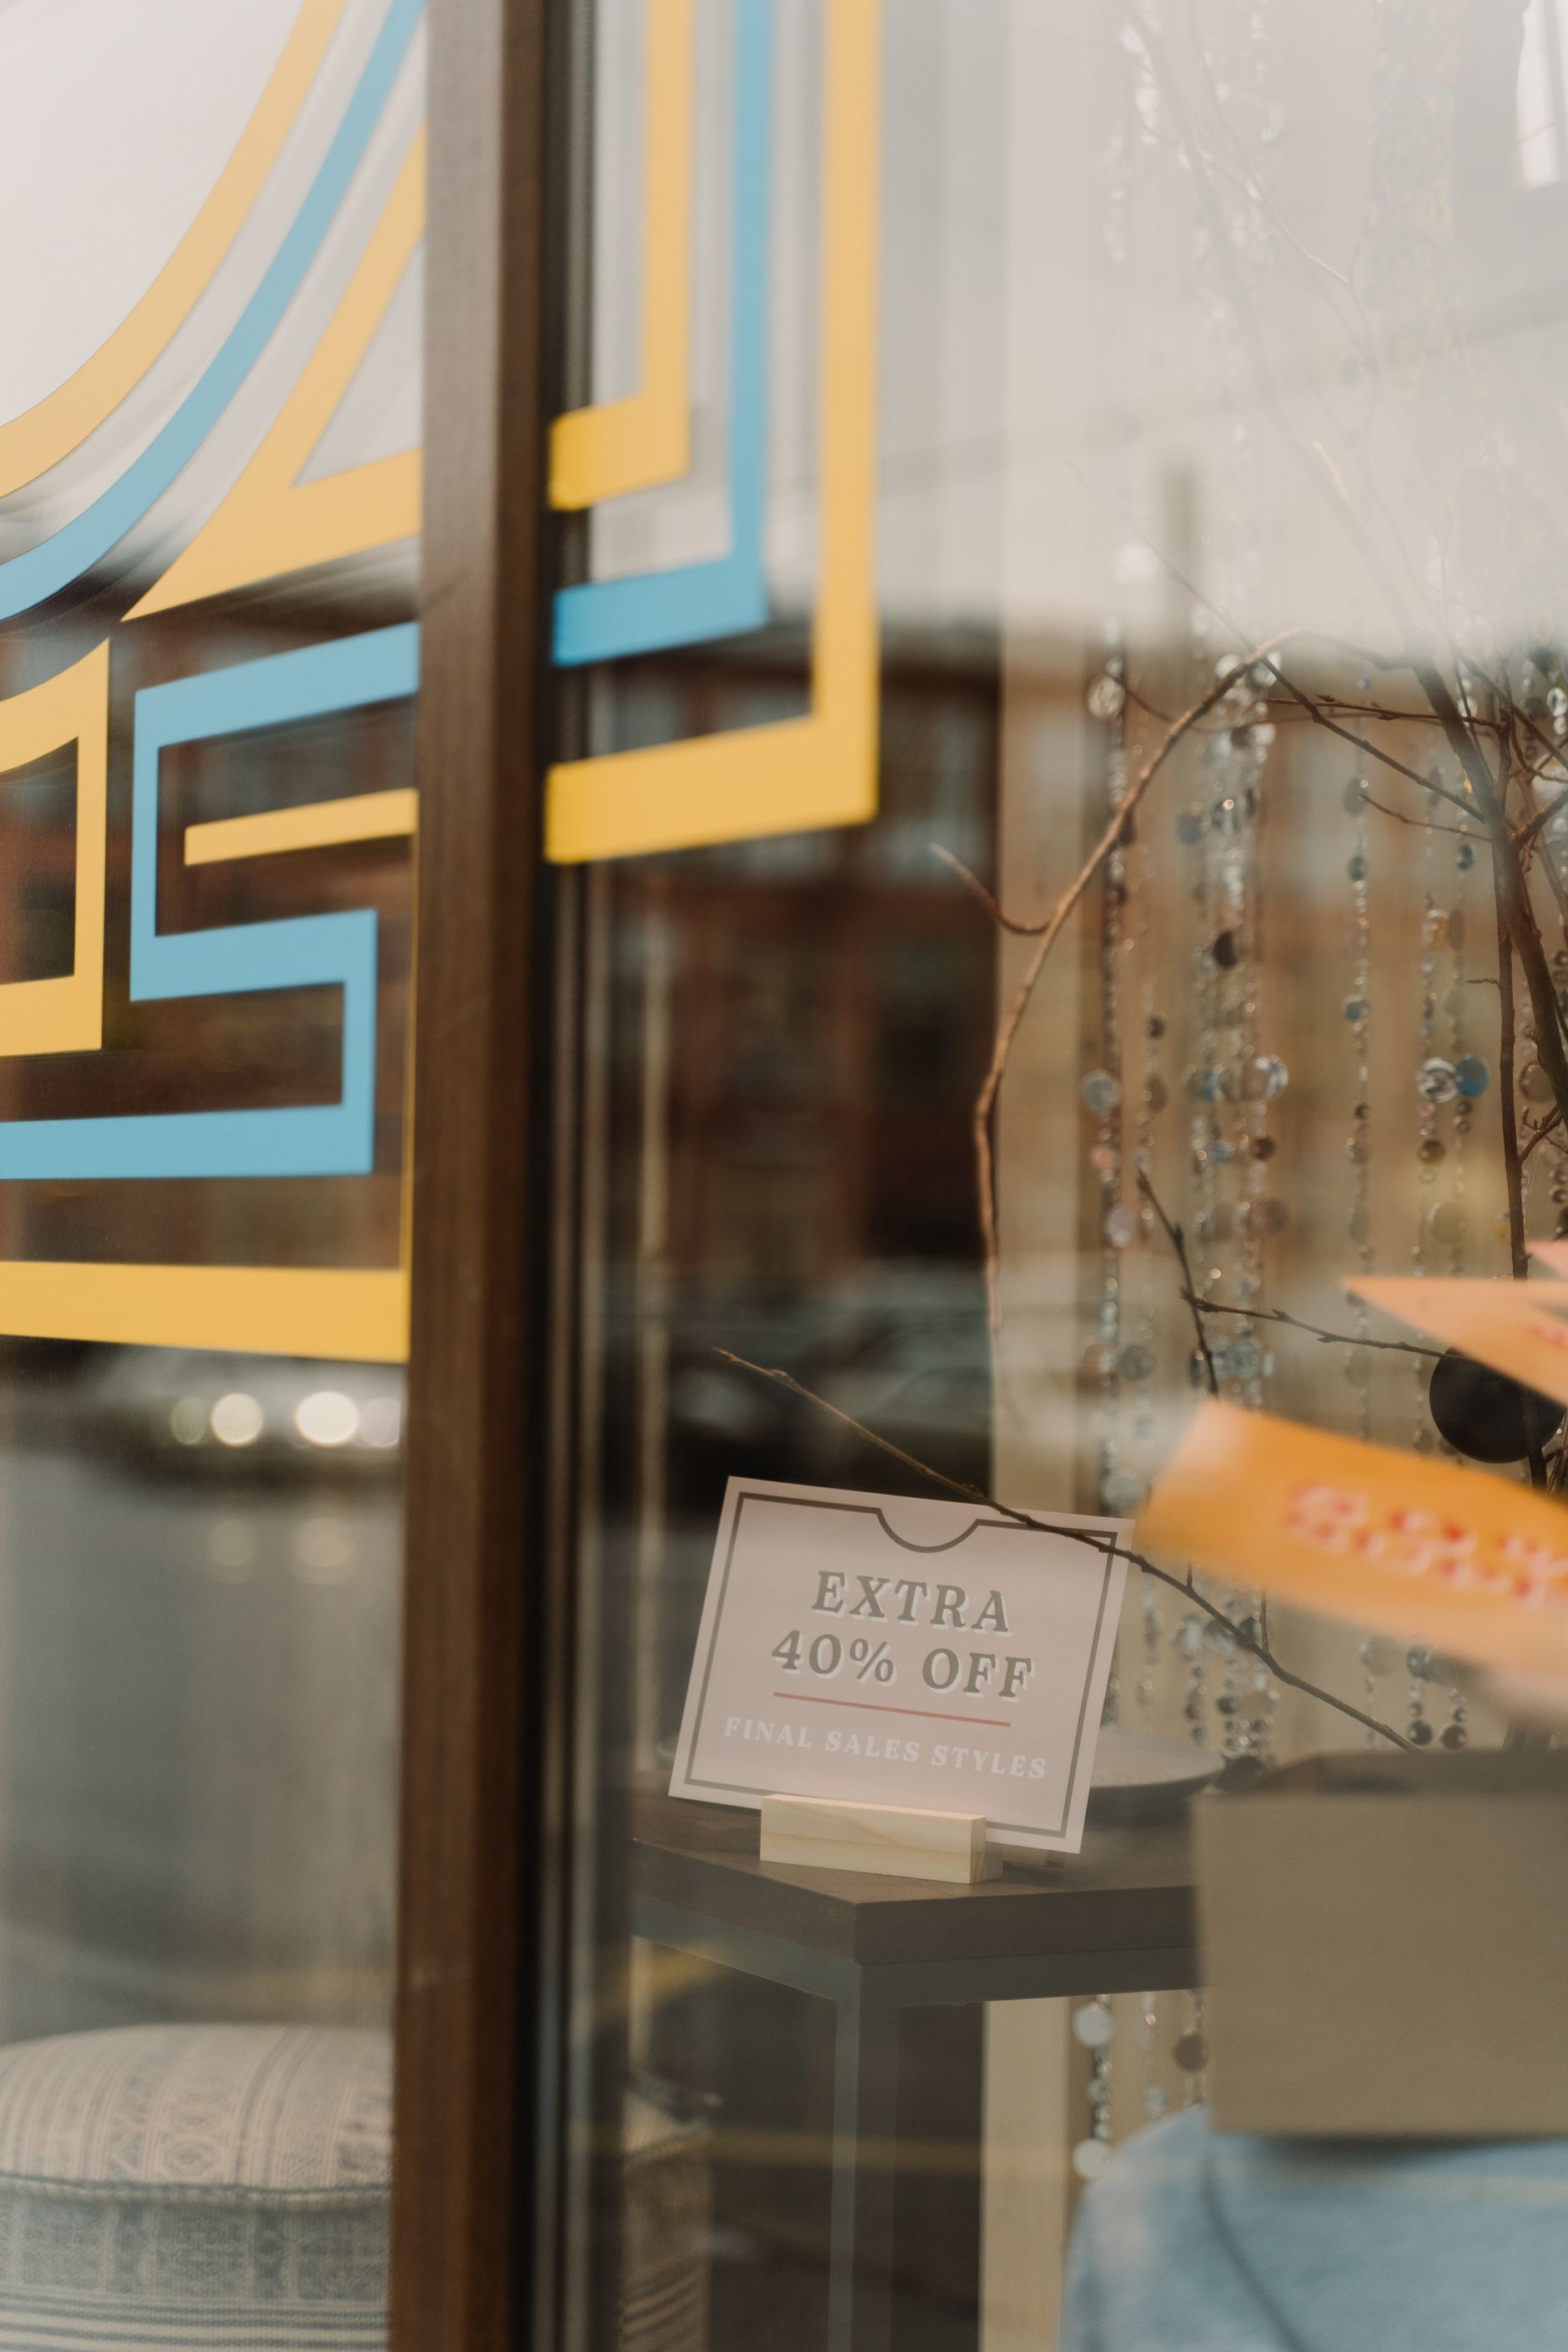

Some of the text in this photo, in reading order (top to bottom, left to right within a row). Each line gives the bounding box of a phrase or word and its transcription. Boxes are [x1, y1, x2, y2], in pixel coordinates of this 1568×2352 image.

[812, 1571, 1012, 1635] EXTRA
[771, 1629, 1033, 1701] 40% OFF
[724, 1717, 1047, 1779] FINAL SALES STYLES
